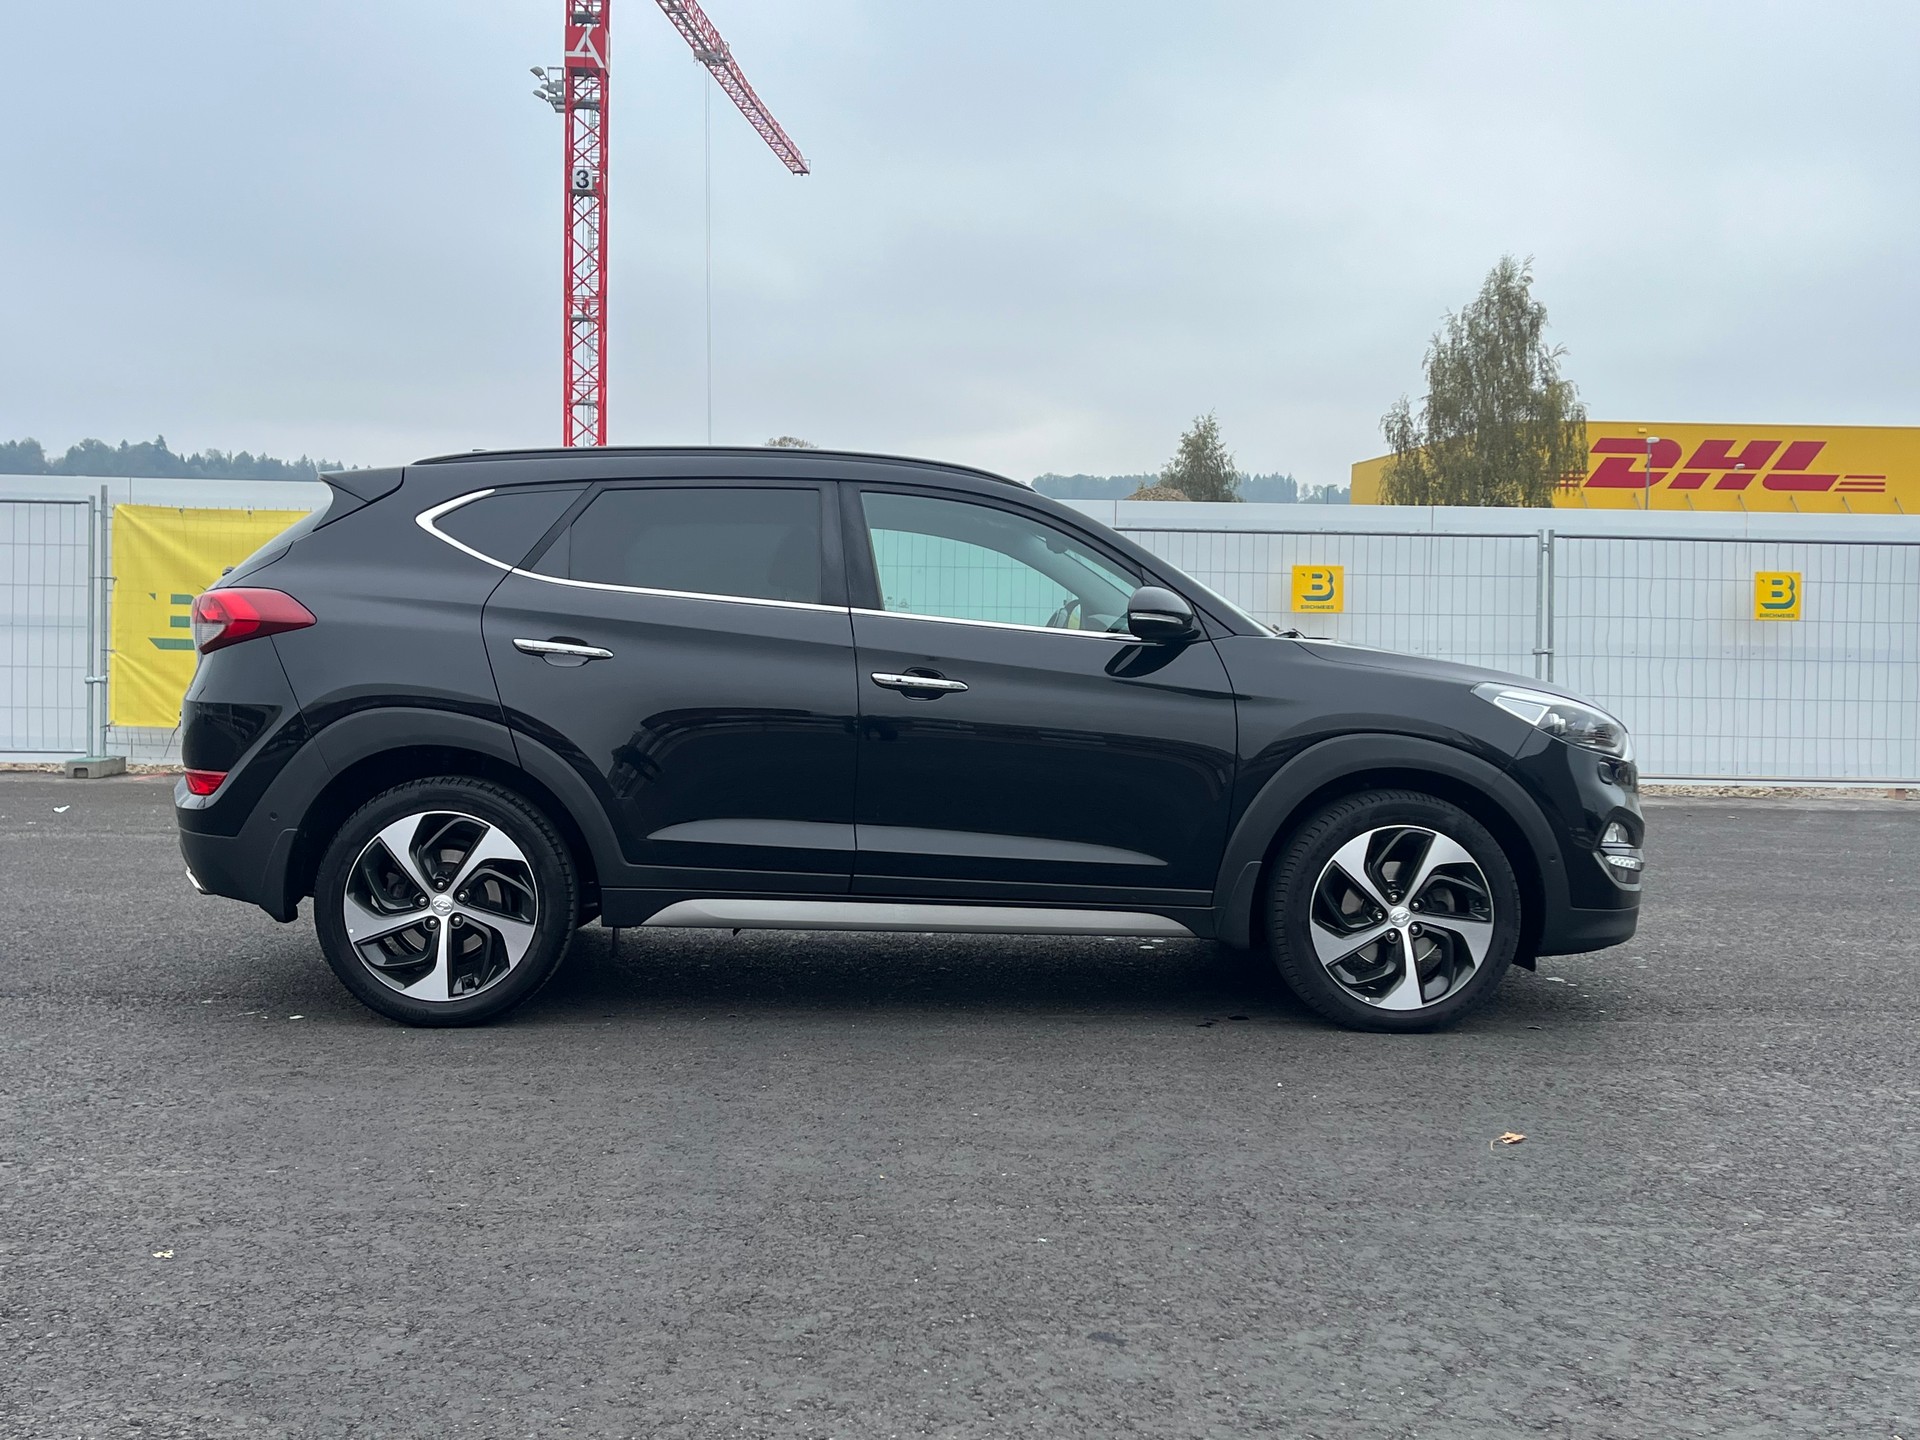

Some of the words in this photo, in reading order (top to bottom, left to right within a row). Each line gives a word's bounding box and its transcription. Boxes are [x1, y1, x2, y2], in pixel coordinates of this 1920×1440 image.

[576, 169, 589, 188] 3
[1583, 438, 1840, 491] DHL
[1300, 569, 1335, 602] B
[1760, 575, 1796, 610] B
